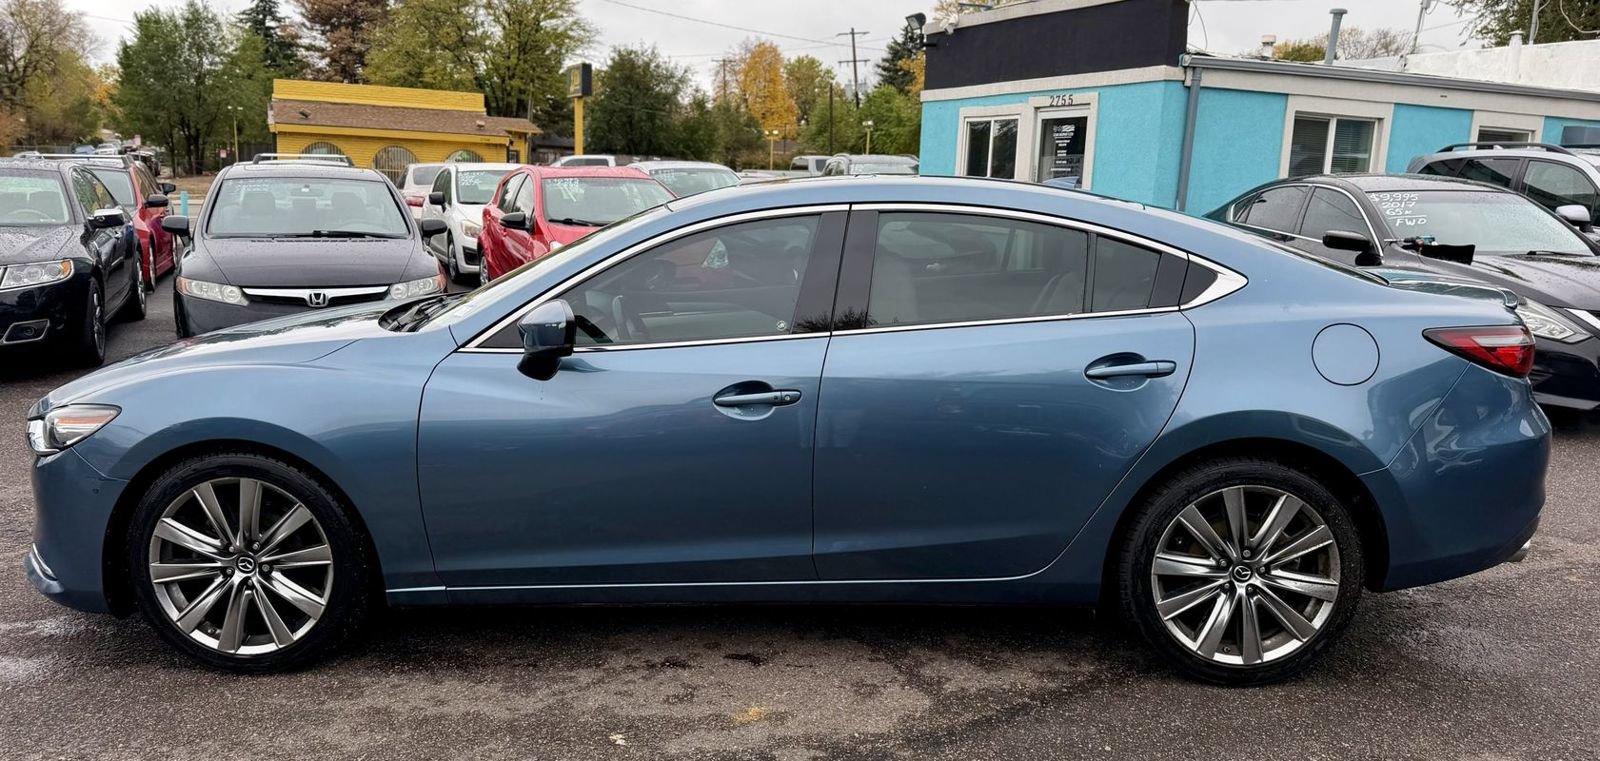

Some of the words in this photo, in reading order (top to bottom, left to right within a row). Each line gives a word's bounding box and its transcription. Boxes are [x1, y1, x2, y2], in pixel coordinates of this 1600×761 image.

[1049, 95, 1073, 106] 2755
[1370, 193, 1418, 201] $9,995
[1396, 218, 1426, 226] FWD
